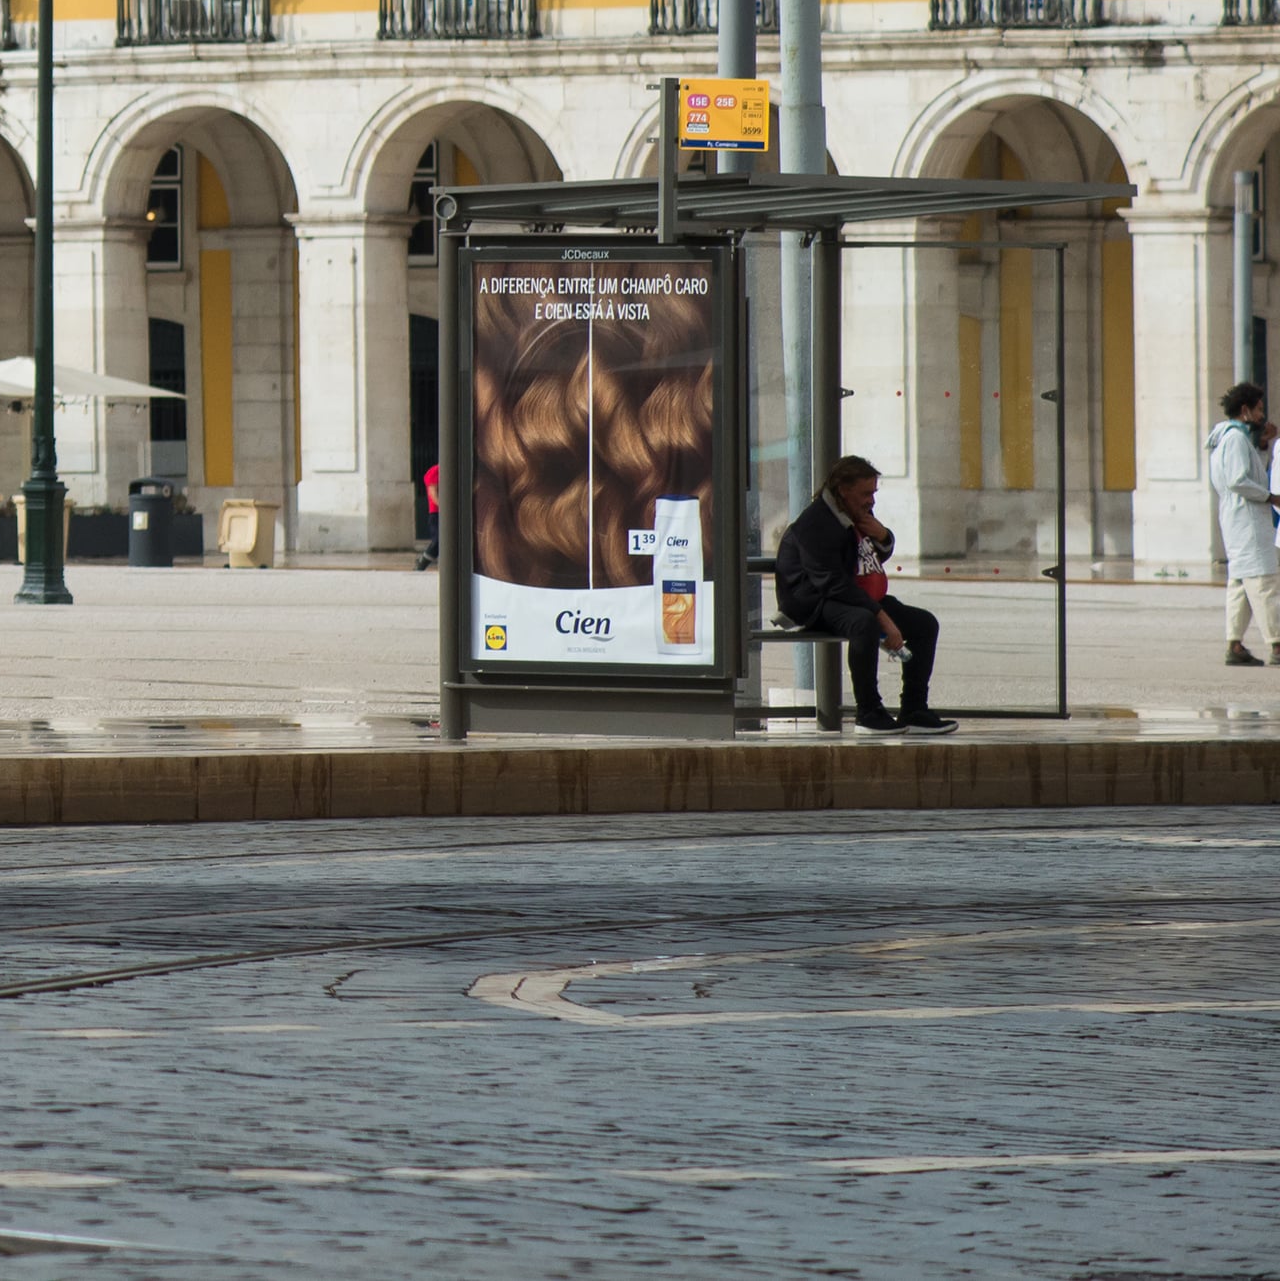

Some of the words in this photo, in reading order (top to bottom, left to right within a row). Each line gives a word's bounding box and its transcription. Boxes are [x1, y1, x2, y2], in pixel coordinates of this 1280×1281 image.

[689, 113, 707, 123] 774
[561, 249, 610, 260] JCDecaux
[480, 278, 488, 294] A
[491, 277, 555, 298] DIFERENÇA
[558, 278, 595, 294] ENTRE
[599, 278, 618, 294] UM
[621, 273, 672, 295] CHAMPÔ
[675, 278, 709, 295] CARO
[535, 303, 543, 320] E
[545, 303, 573, 320] CIEN
[575, 299, 604, 320] ESTÁ
[605, 299, 615, 320] À
[617, 303, 650, 320] VISTA
[666, 536, 689, 547] Cien
[555, 610, 611, 635] Cien
